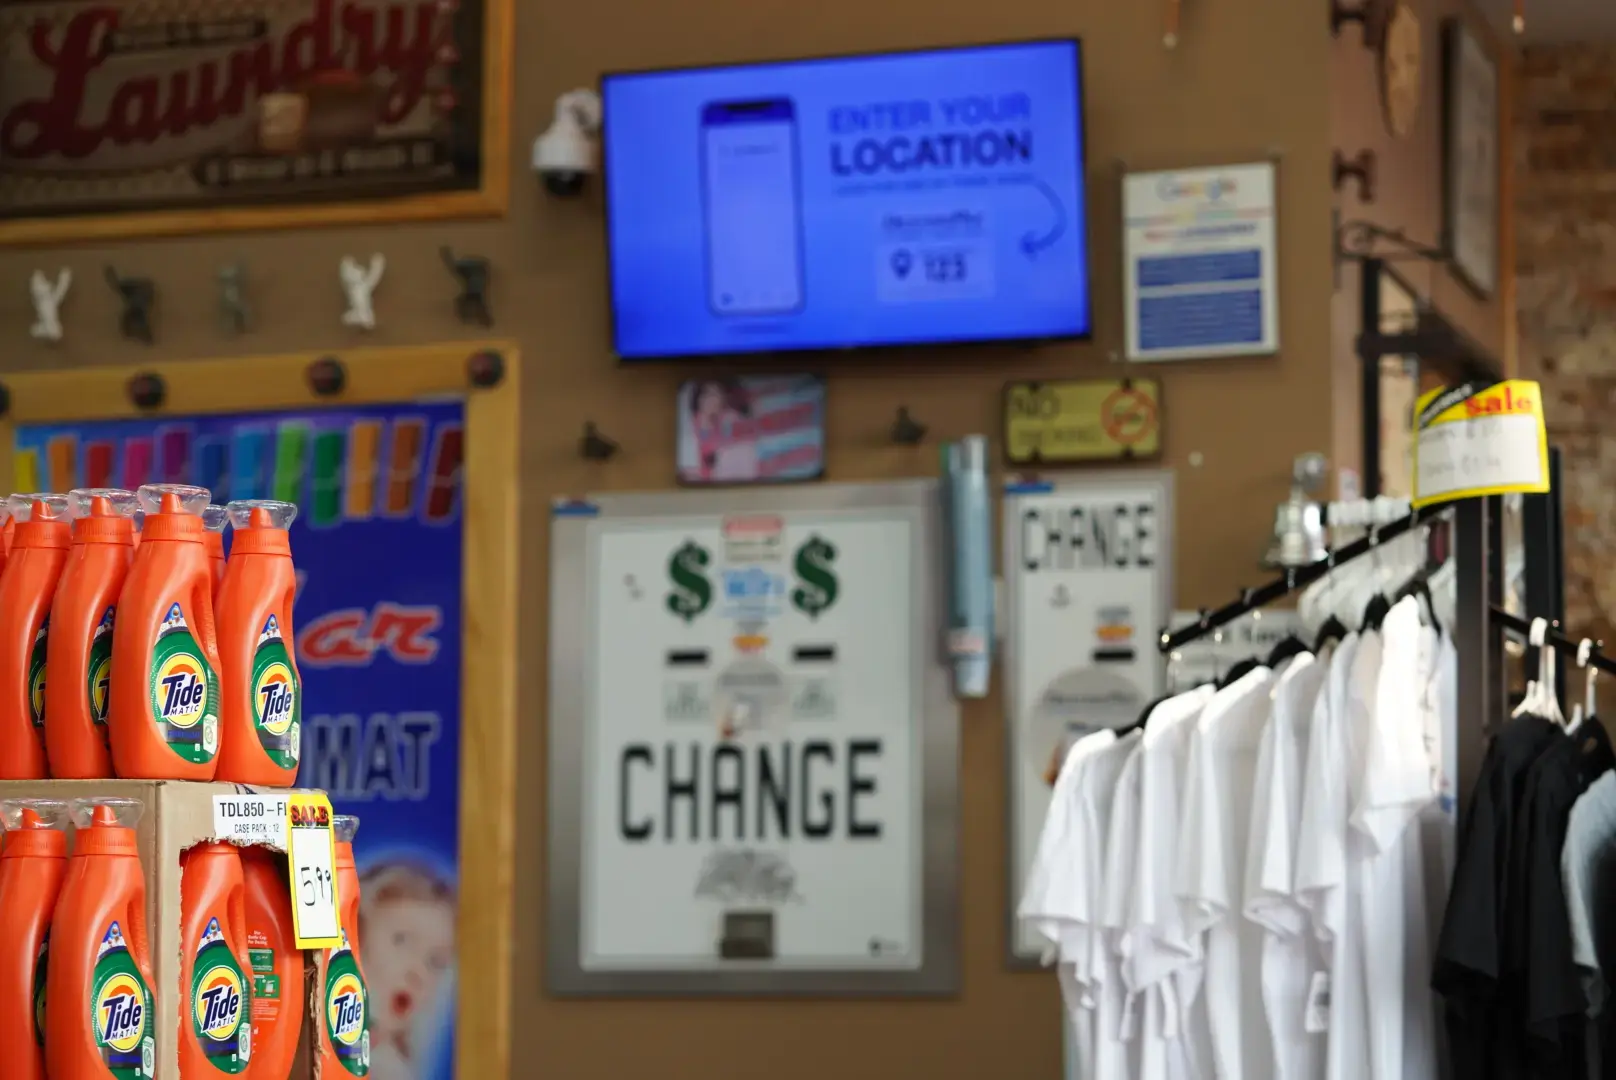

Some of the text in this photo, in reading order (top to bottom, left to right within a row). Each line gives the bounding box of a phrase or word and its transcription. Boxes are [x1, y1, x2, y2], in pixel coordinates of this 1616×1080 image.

[1, 0, 441, 158] Laundry
[828, 91, 1031, 134] ENTER YOUR
[830, 128, 1034, 176] LOCATION
[1464, 386, 1532, 417] sale
[1023, 504, 1154, 570] CHANGE
[162, 674, 204, 716] Tide
[170, 704, 199, 716] MATIC
[261, 683, 292, 724] Tide
[267, 712, 290, 723] MATIC
[220, 802, 264, 817] TDL850
[619, 738, 883, 842] CHANGE
[235, 823, 250, 833] CASE
[252, 823, 267, 833] PACK
[290, 805, 329, 824] SALE
[102, 995, 141, 1040] Tide
[201, 986, 239, 1032] Tide
[209, 1015, 236, 1030] MATIC
[333, 995, 362, 1037] Tide
[340, 1022, 361, 1035] MATIC
[111, 1027, 139, 1040] MATIC
